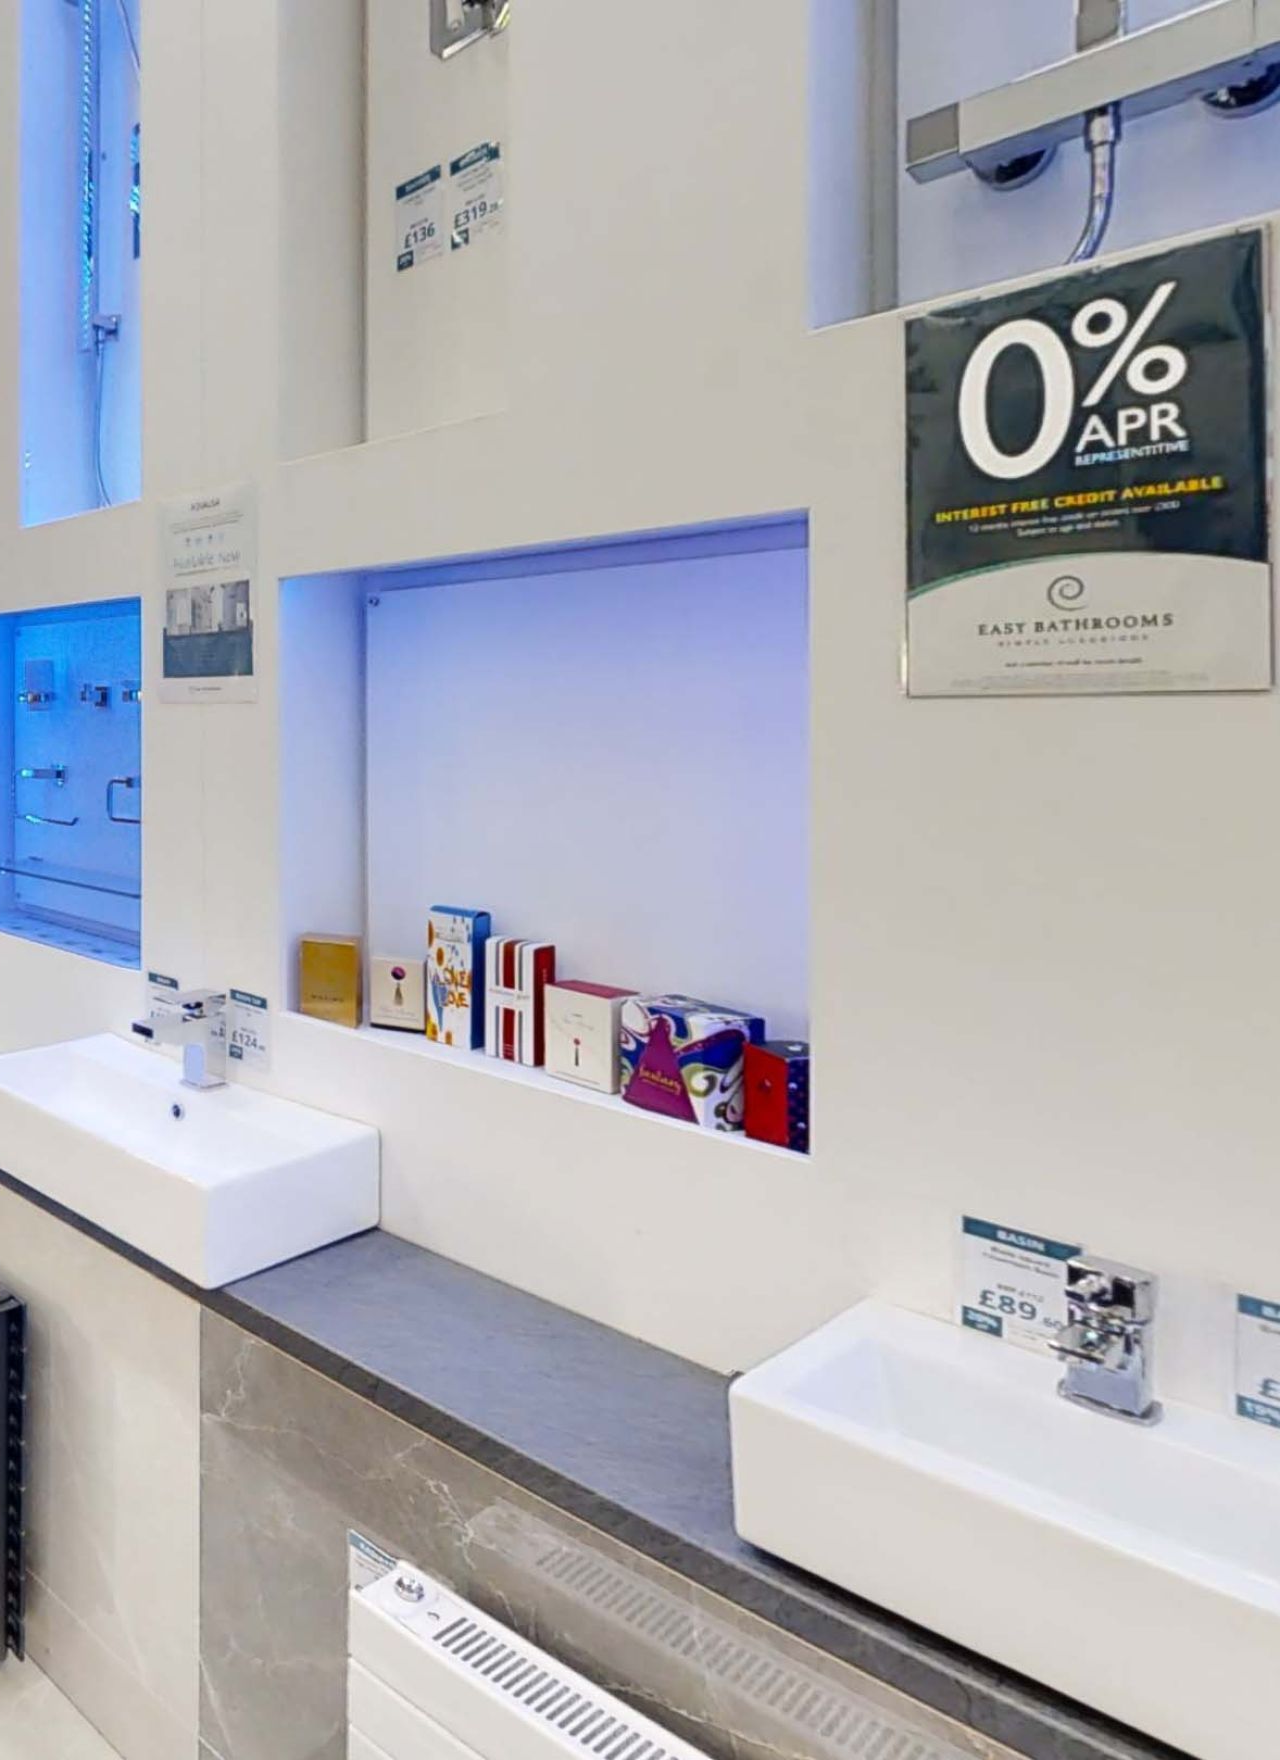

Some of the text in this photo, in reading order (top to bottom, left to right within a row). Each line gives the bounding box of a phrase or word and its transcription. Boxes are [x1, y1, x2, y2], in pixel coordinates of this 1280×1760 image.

[958, 281, 1187, 479] 0%
[1074, 402, 1187, 452] APR
[935, 475, 1225, 524] INTEREST FREE CREDIT AVAILABLE
[978, 612, 1174, 636] EASY BATHROOMS
[231, 1030, 258, 1049] £124
[996, 1230, 1046, 1252] BASIN
[978, 1288, 1038, 1321] £89
